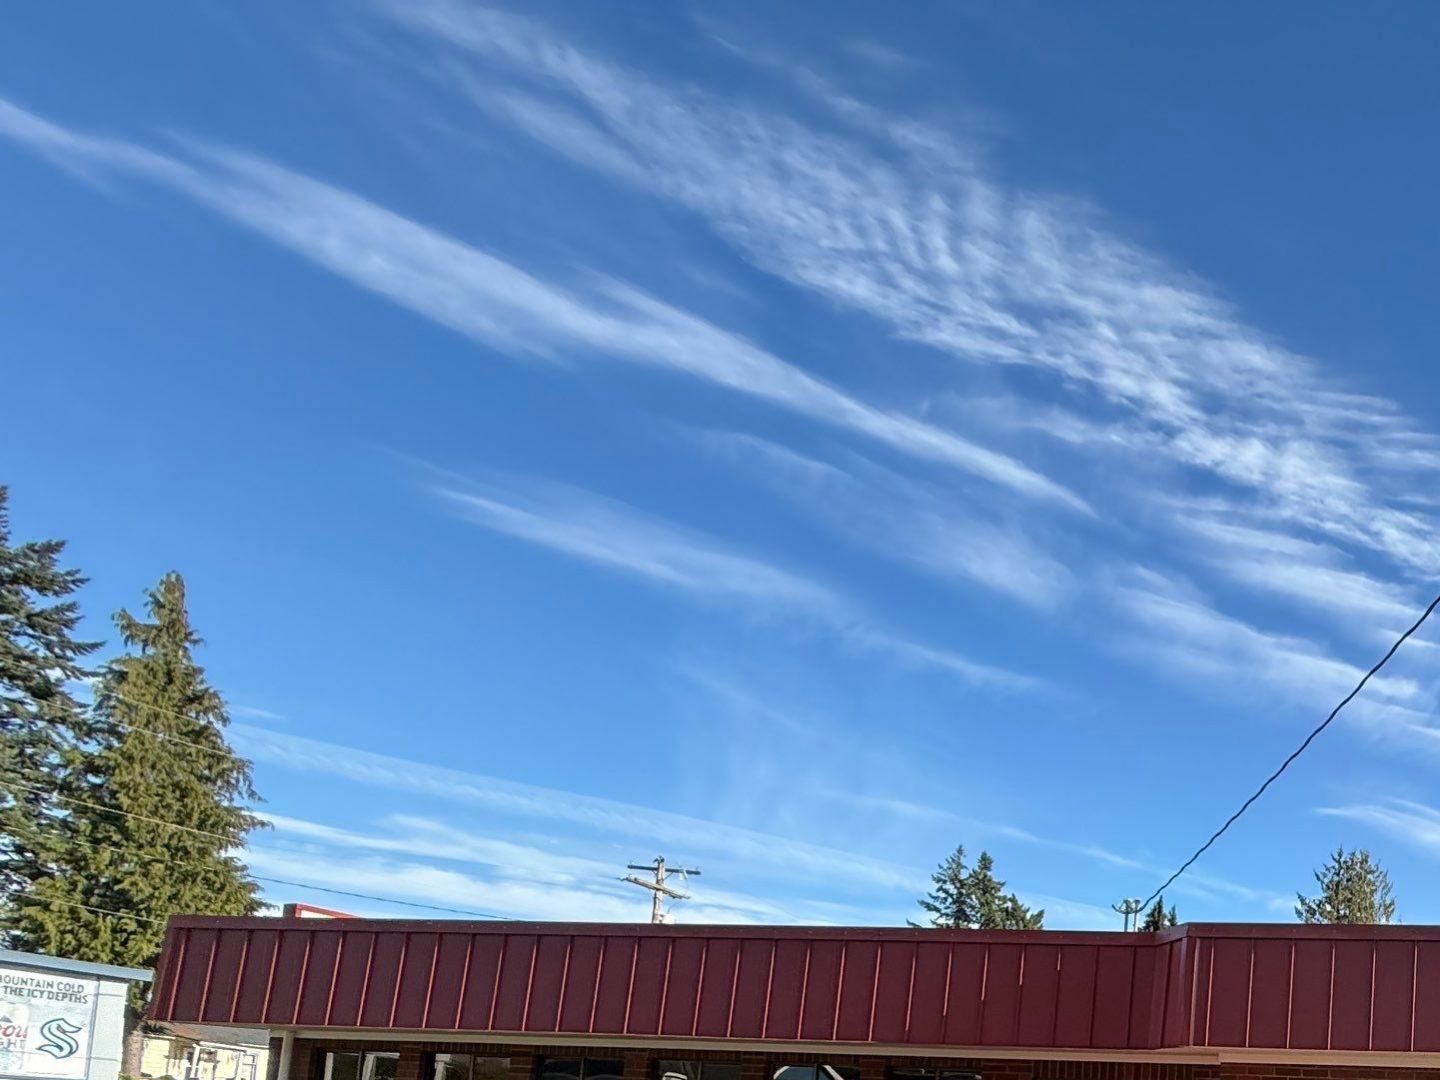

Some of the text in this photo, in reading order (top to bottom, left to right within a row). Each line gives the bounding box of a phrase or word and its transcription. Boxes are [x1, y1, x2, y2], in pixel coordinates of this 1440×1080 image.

[4, 986, 88, 1004] THE ICY DEPTHS
[57, 982, 84, 994] COLD
